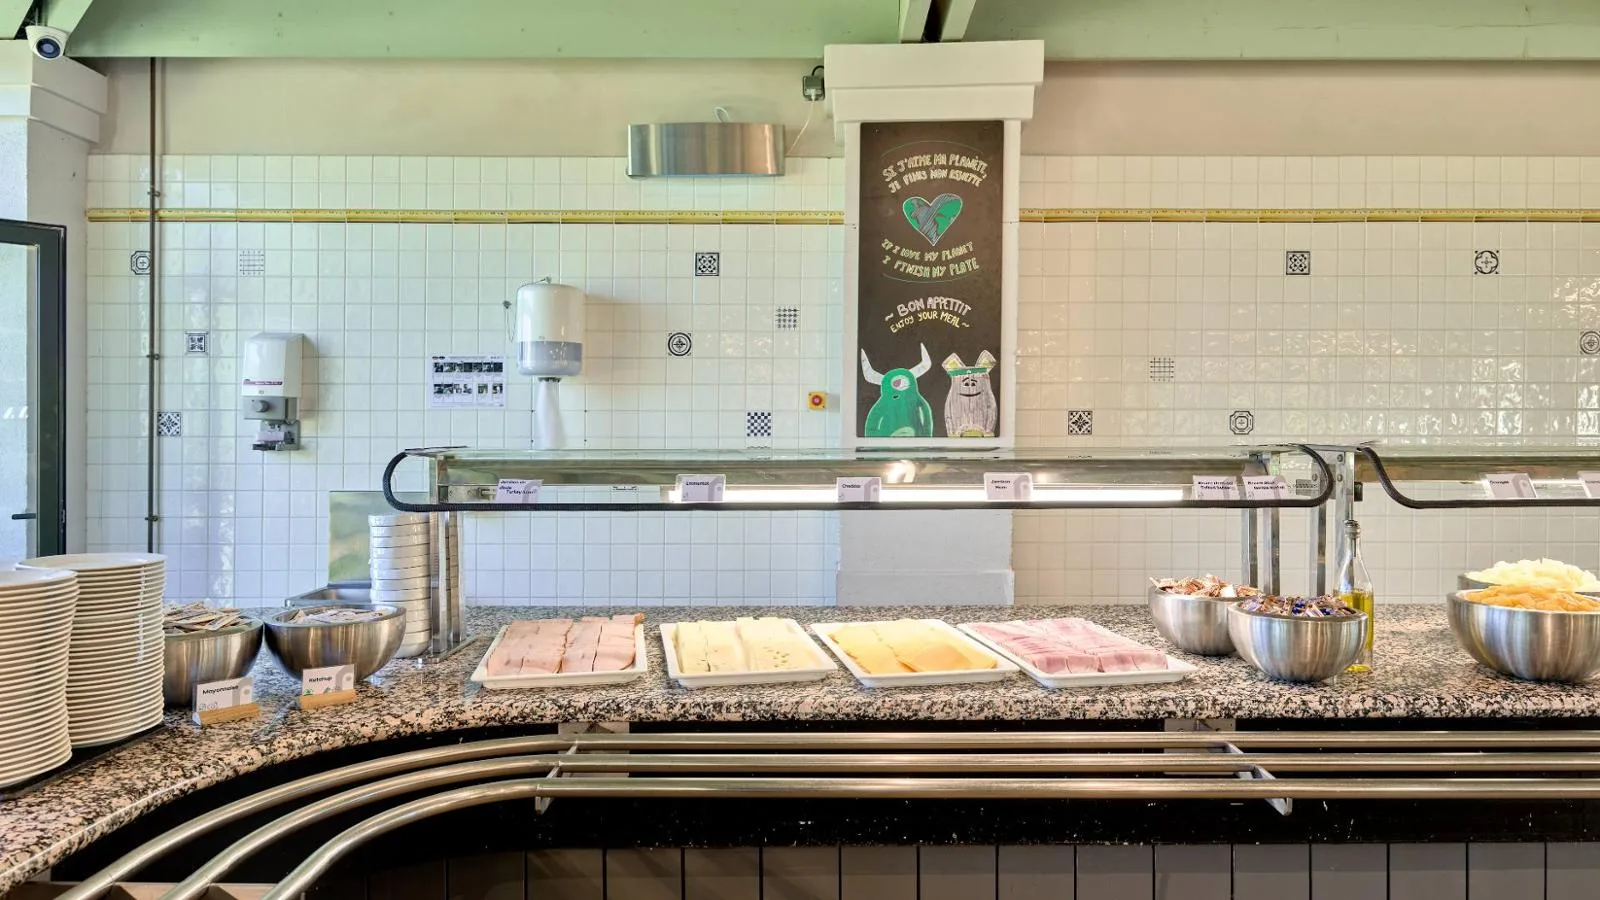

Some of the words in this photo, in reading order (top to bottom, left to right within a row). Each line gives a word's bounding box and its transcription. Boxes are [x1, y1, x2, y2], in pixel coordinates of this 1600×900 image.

[924, 251, 939, 261] MY
[941, 241, 973, 261] PLANET
[893, 260, 930, 278] FINISH
[932, 265, 947, 278] MY
[949, 257, 980, 276] PLATE
[896, 298, 926, 317] BON
[890, 315, 915, 333] ENJOY
[917, 310, 938, 322] YOUR
[940, 311, 960, 328] MEAL
[202, 684, 239, 695] Mayonnaise
